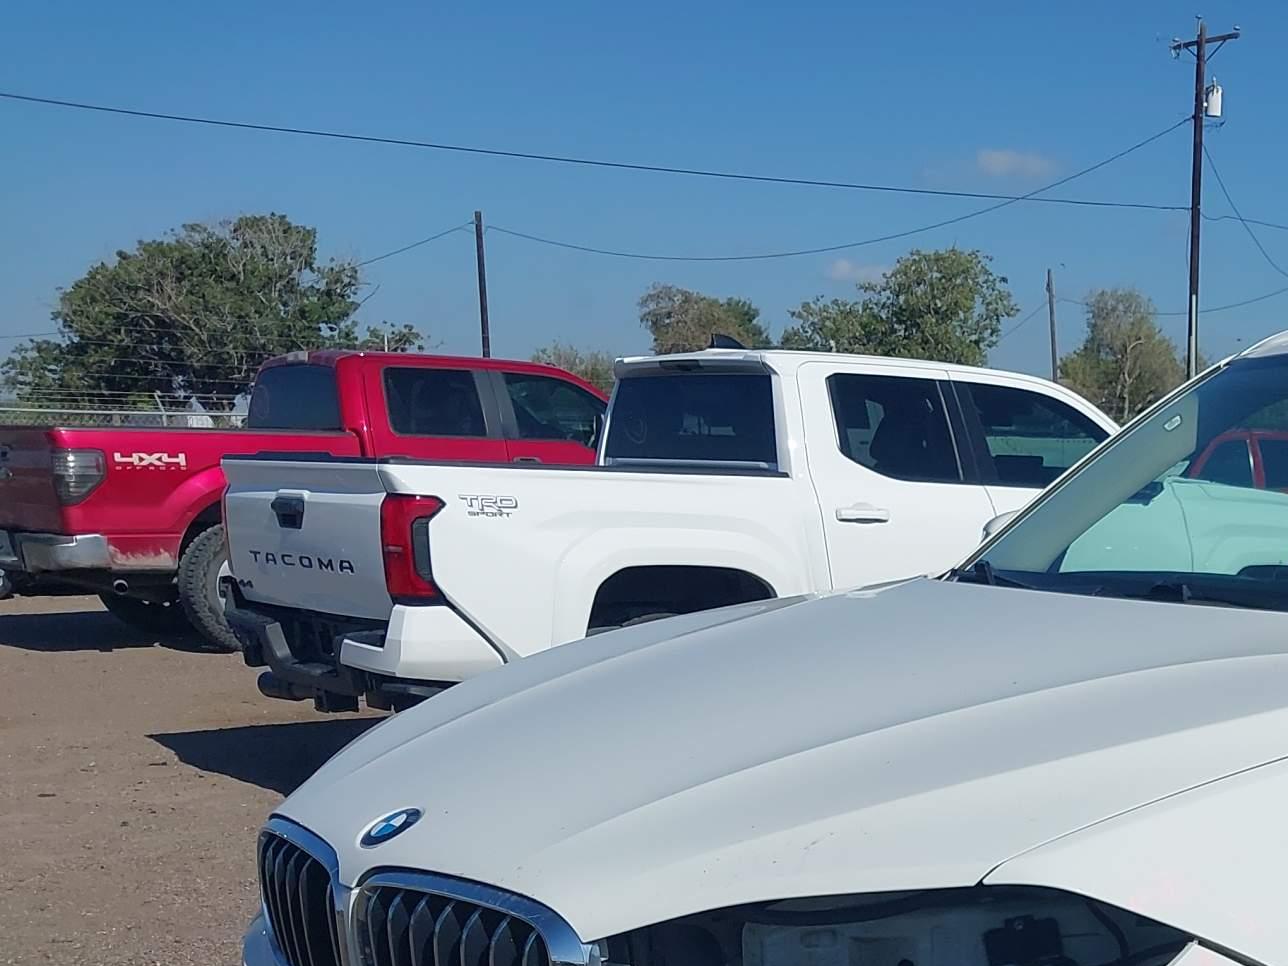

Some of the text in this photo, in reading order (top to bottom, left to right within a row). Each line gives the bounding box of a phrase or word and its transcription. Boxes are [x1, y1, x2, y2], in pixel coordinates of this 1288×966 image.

[458, 494, 518, 512] TRD
[467, 511, 513, 519] SPORT
[249, 549, 355, 574] TACOMA
